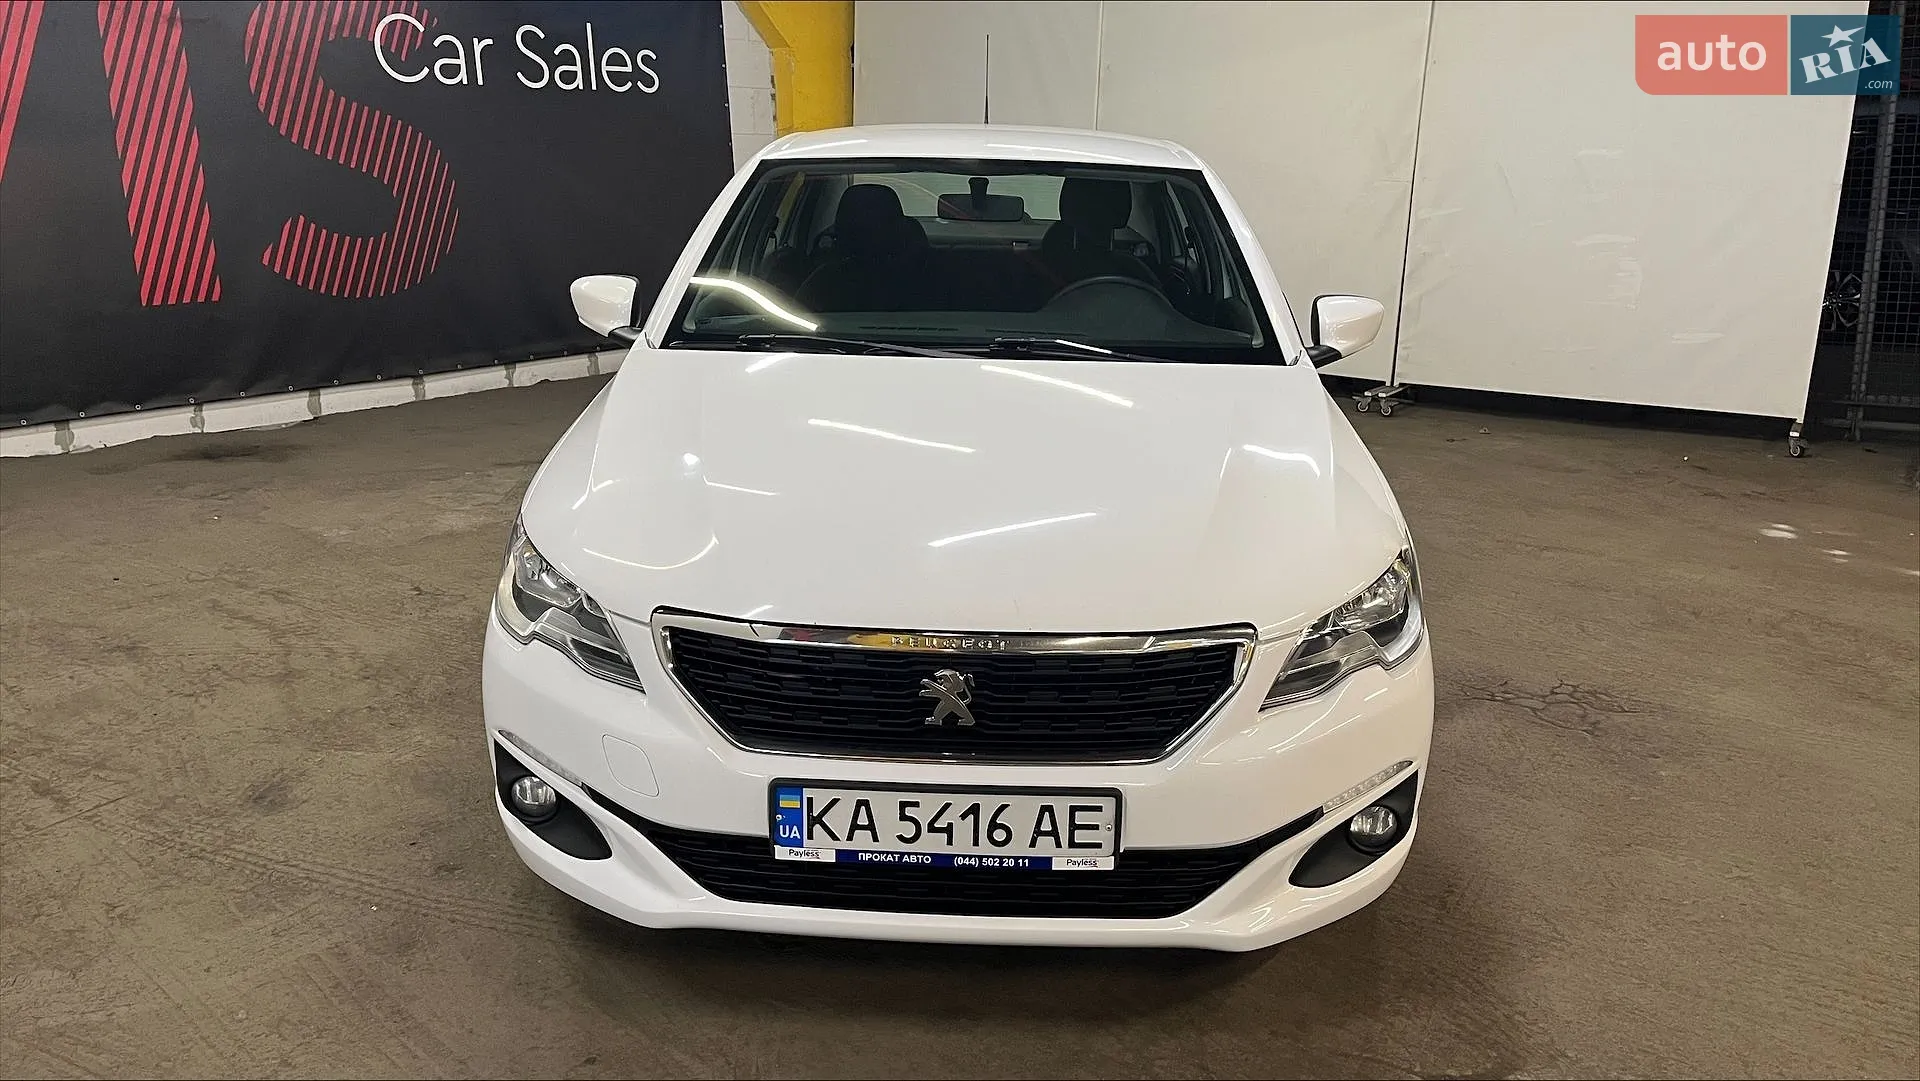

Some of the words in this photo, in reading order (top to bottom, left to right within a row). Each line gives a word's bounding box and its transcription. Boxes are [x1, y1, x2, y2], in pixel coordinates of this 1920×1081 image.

[374, 13, 494, 86] Car
[515, 22, 660, 93] Sales
[806, 796, 880, 843] KA
[895, 800, 1013, 848] 5416
[1028, 804, 1104, 849] AE
[779, 825, 800, 838] UA
[788, 849, 821, 858] Payless
[858, 852, 900, 862] ПРОКАТ
[902, 854, 932, 864] АВТО
[954, 856, 979, 867] (044)
[982, 858, 1000, 867] 502
[1002, 858, 1015, 867] 20
[1018, 858, 1029, 867] 11
[1066, 858, 1098, 868] Payless
